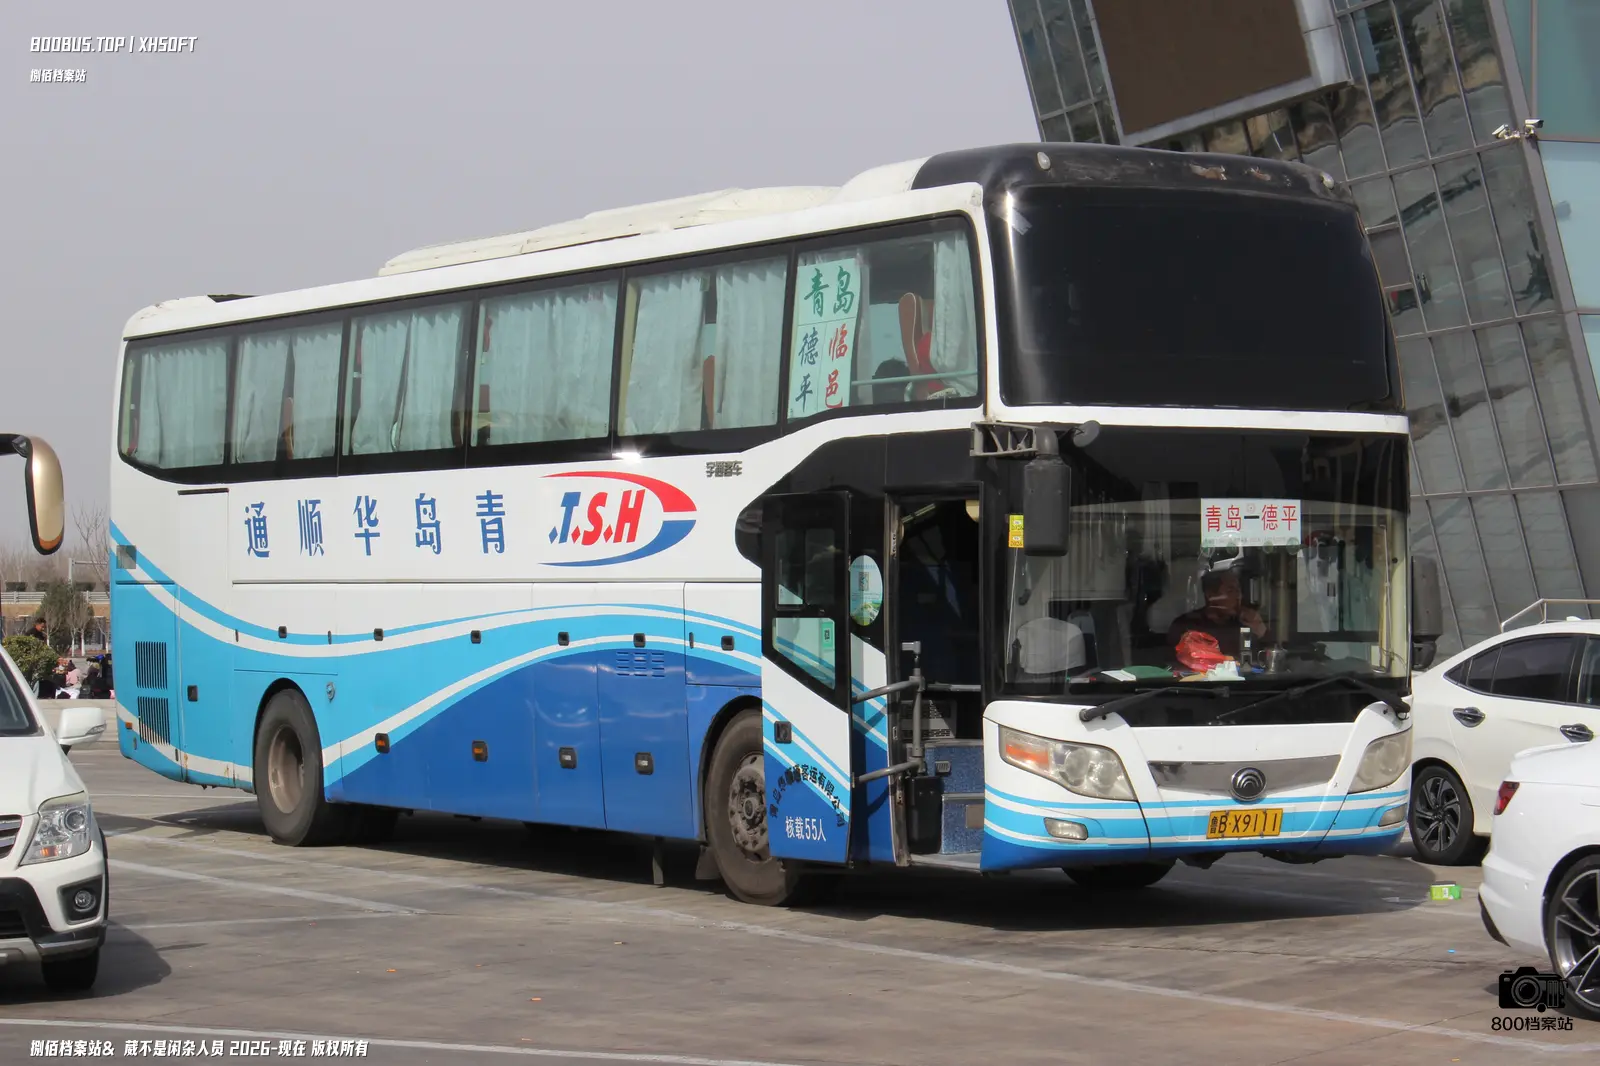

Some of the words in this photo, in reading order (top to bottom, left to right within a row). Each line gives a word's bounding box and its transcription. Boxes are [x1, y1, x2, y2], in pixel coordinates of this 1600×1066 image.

[804, 265, 855, 317] 青岛
[795, 327, 819, 413] 德平
[825, 323, 849, 409] 临邑
[785, 815, 827, 842] 核载55人
